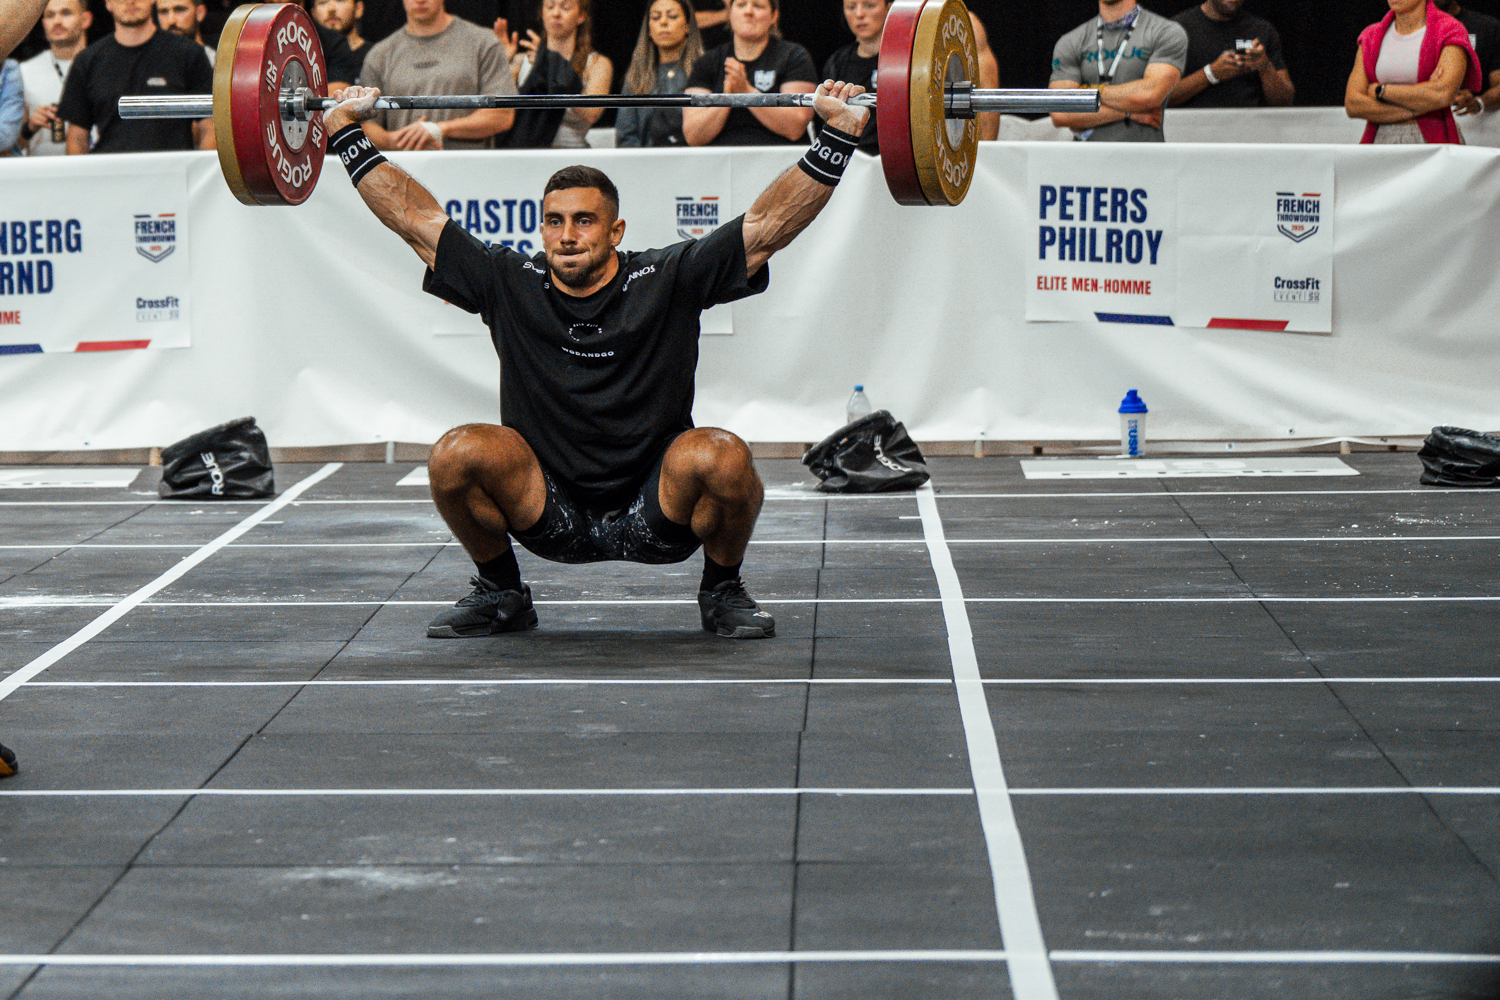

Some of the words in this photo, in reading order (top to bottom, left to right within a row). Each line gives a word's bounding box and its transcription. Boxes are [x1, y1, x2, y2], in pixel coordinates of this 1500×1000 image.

[276, 21, 323, 90] ROGUE
[941, 14, 975, 83] ROGUE
[266, 120, 313, 188] ROGUE
[934, 121, 968, 187] ROGUE
[445, 199, 544, 234] CASTO
[676, 203, 718, 217] FRENCH
[1038, 184, 1148, 224] PETERS
[1277, 199, 1320, 213] FRENCH
[134, 220, 175, 234] FRENCH
[1277, 214, 1320, 222] THROWDOWN
[1038, 225, 1163, 265] PHILROY
[1036, 275, 1067, 291] ELITE
[1071, 277, 1151, 295] MEN-HOMME
[1274, 277, 1320, 290] CrossFit
[136, 296, 179, 309] CrossFit
